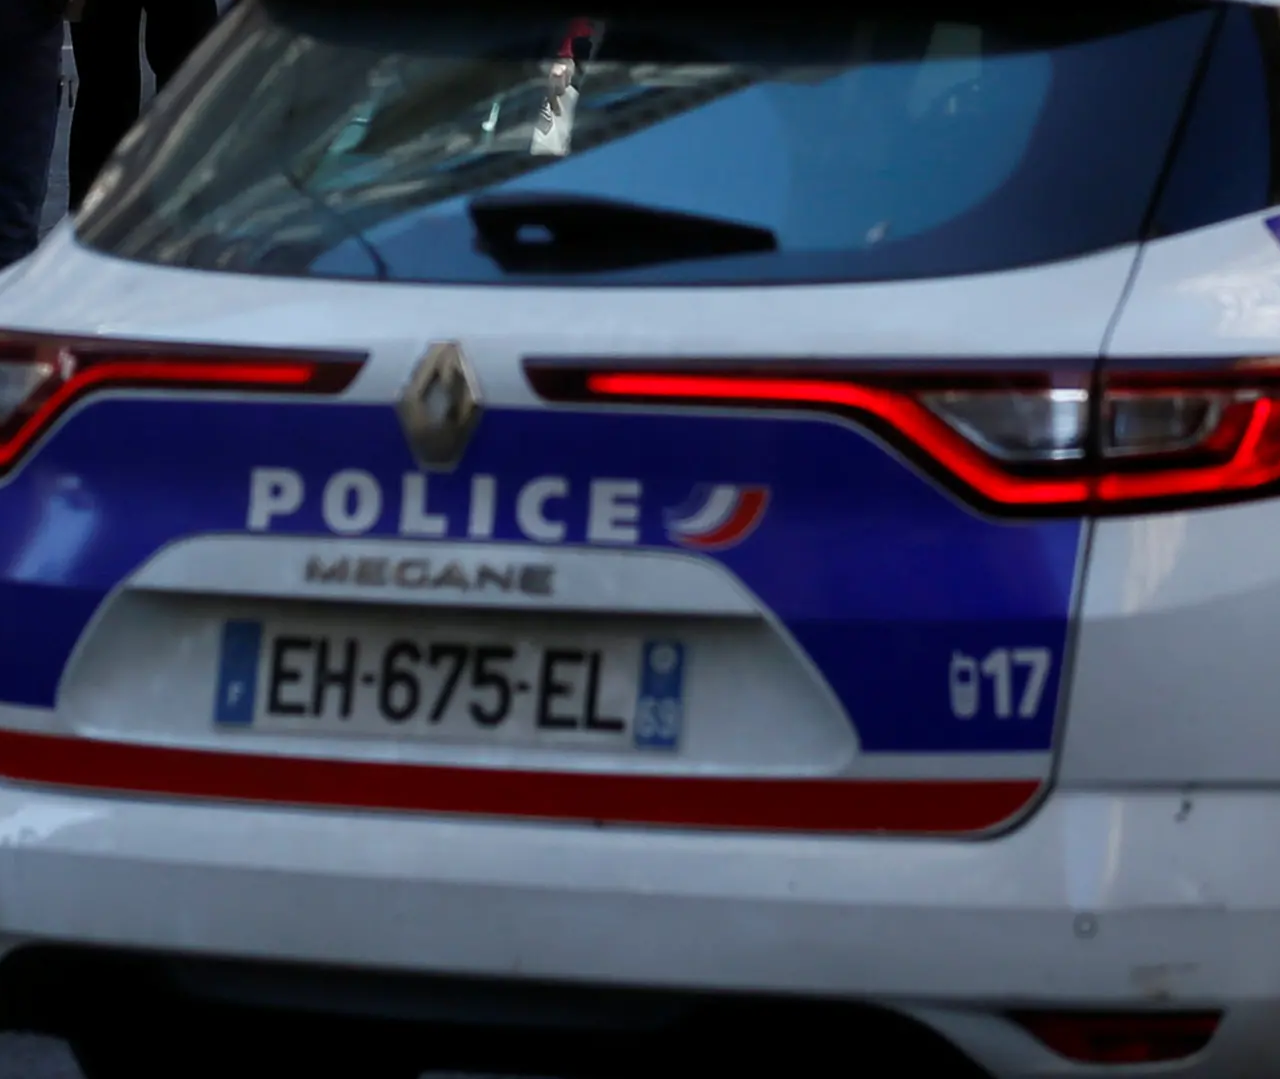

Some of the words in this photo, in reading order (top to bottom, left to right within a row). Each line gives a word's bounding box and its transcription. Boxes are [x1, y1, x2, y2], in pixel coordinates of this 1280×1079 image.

[245, 466, 644, 545] POLICE
[302, 554, 558, 597] MEGANE
[266, 634, 625, 733] EH-675-EL
